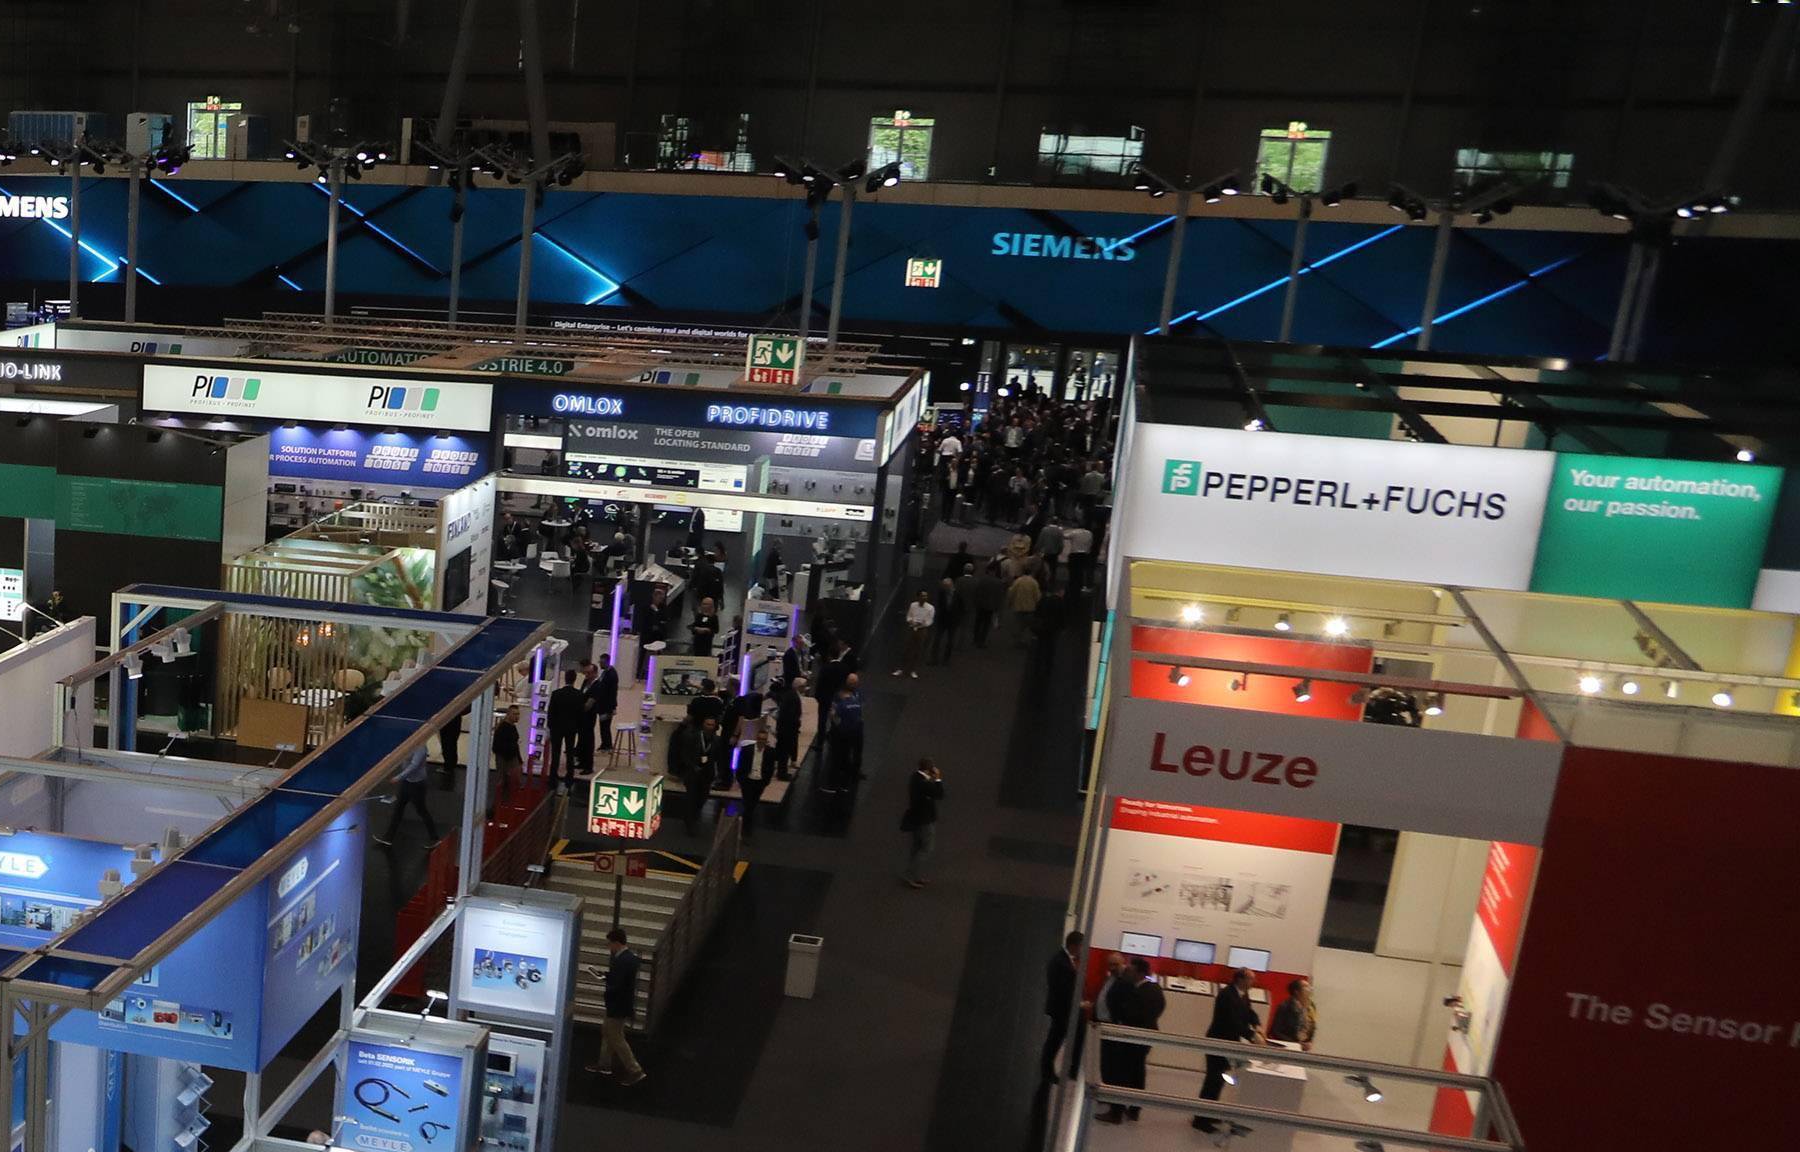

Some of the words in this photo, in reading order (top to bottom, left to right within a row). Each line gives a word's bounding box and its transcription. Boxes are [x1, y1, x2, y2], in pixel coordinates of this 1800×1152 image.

[992, 232, 1136, 262] SIEMENS
[554, 321, 577, 329] Digital
[577, 322, 610, 331] Enterprise
[538, 360, 563, 374] 4.0
[552, 394, 623, 415] OMLOX
[707, 405, 829, 430] PROFIDRIVE
[585, 424, 639, 442] omlox
[655, 427, 675, 437] THE
[675, 429, 700, 439] OPEN
[281, 445, 318, 455] SOLUTION
[318, 448, 357, 458] PLATFORM
[654, 438, 700, 449] LOCATING
[700, 441, 751, 453] STANDARD
[276, 455, 307, 464] PROCESS
[308, 457, 357, 467] AUTOMATION
[1570, 469, 1621, 489] Your
[1625, 475, 1761, 502] automation,
[1202, 472, 1507, 520] PEPPERL+FUCHS
[1564, 497, 1602, 512] our
[1605, 500, 1701, 519] passion.
[1151, 732, 1319, 789] Leuze
[1566, 991, 1633, 1025] The
[1644, 1002, 1783, 1045] Sensor
[358, 1050, 376, 1060] Beta
[360, 1136, 408, 1152] MEYLE
